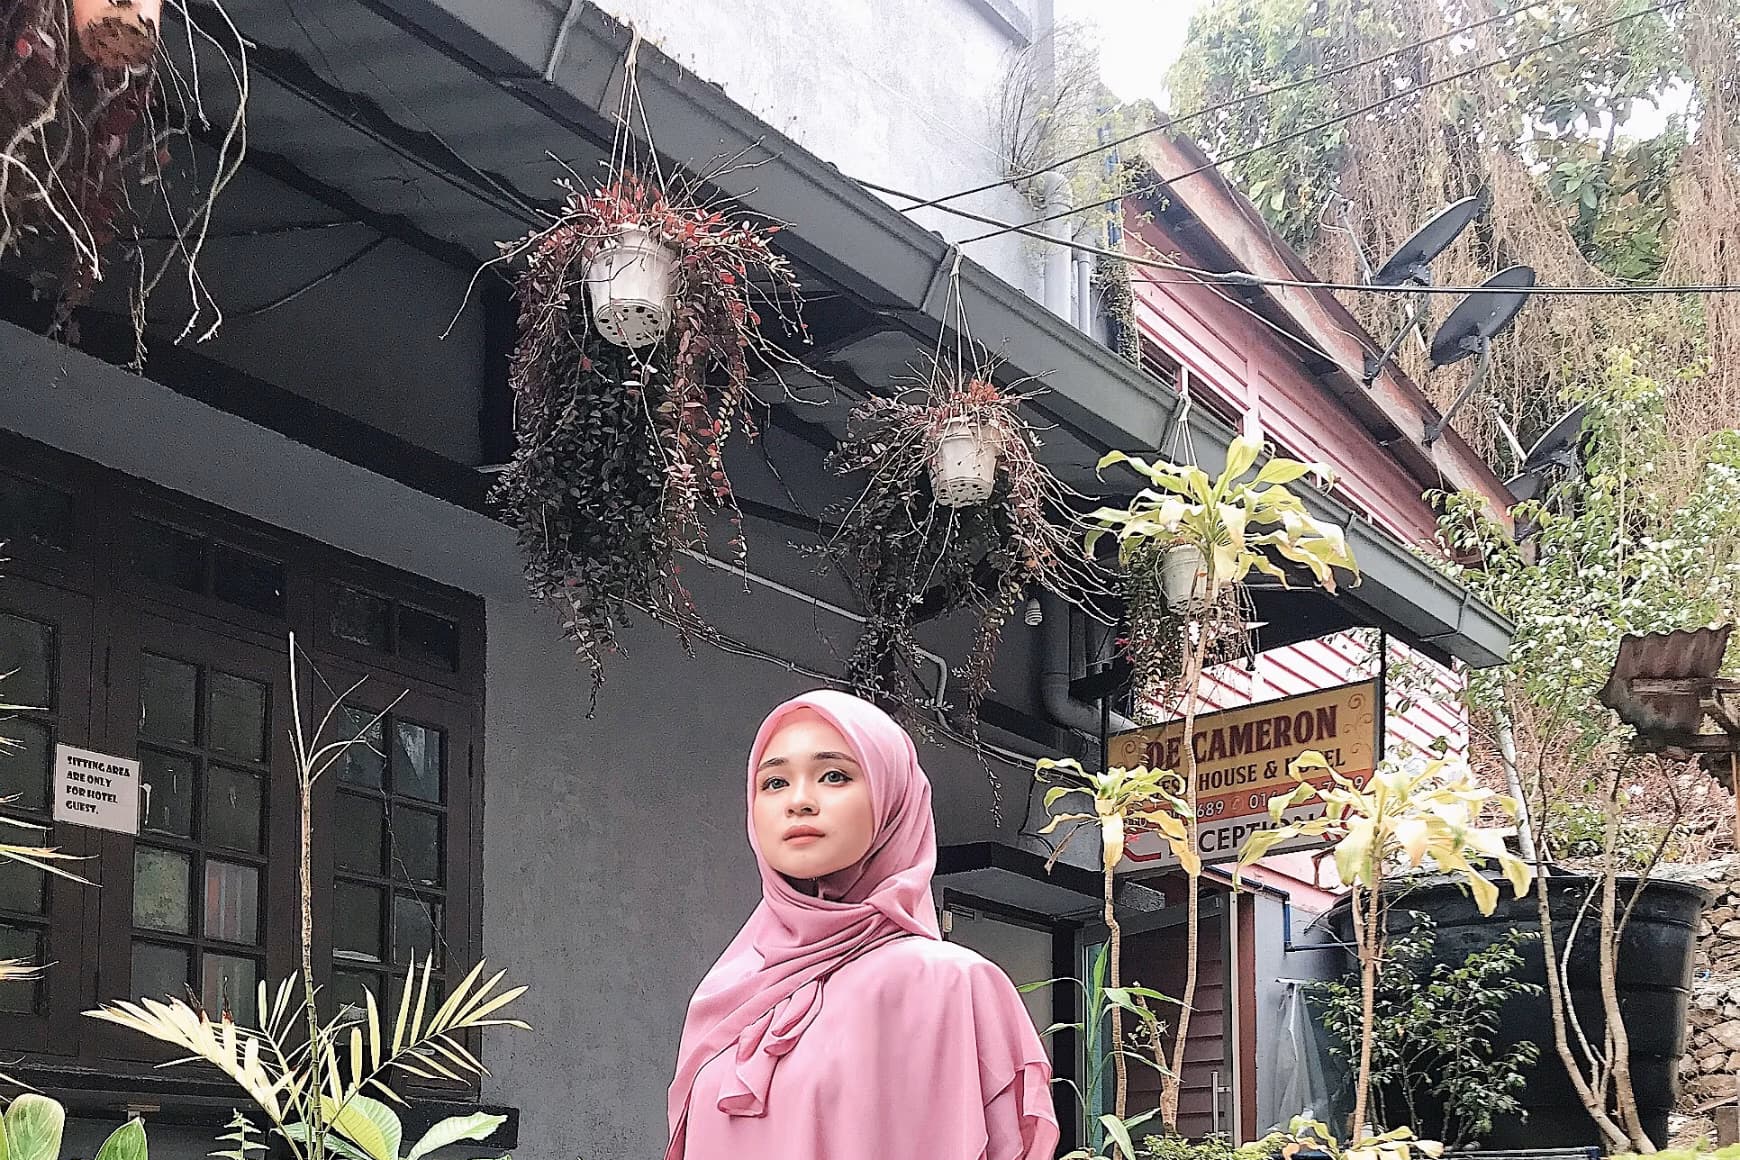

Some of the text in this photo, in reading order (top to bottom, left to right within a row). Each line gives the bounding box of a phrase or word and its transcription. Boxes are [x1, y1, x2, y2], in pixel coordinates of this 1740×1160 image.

[1145, 704, 1338, 770] DE CAMERON
[67, 755, 130, 777] SITTING AREA
[1199, 764, 1258, 791] HOUSE
[1263, 760, 1278, 779] &
[66, 770, 113, 788] ARE ONLY
[66, 785, 119, 804] FOR HOTEL
